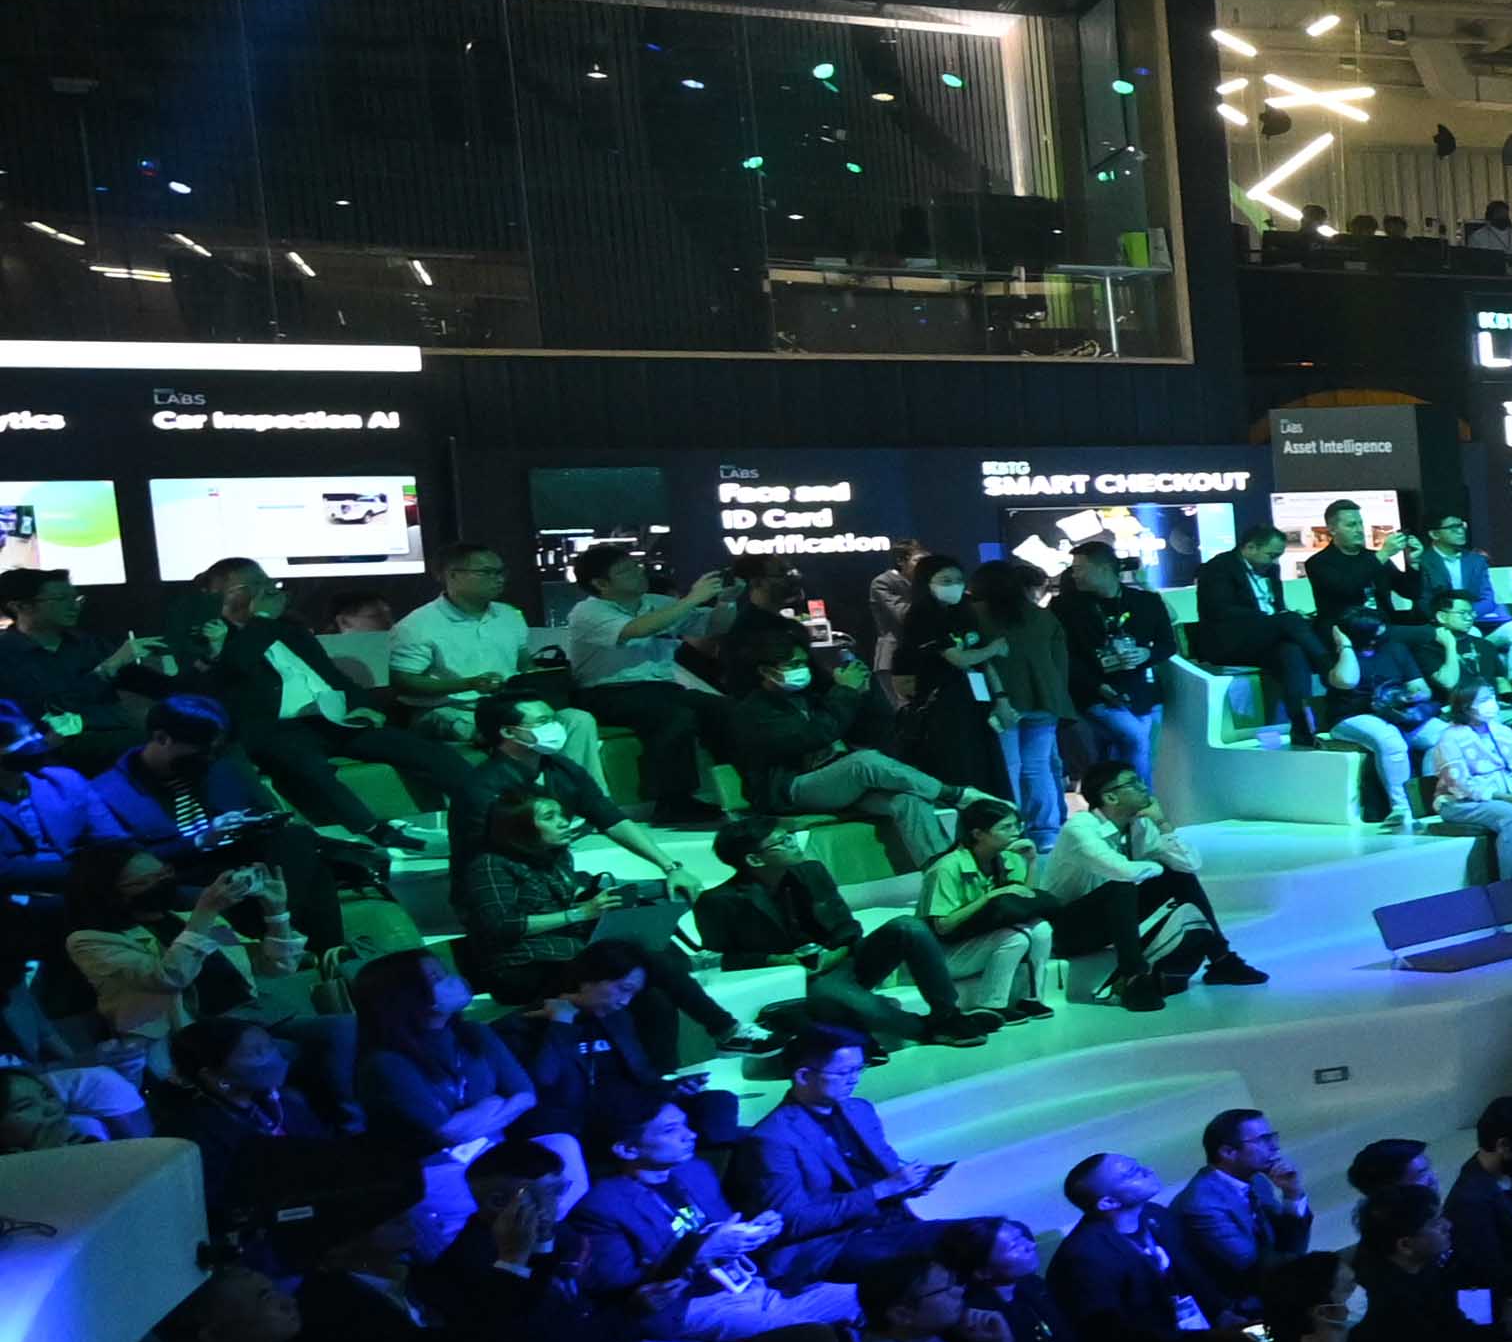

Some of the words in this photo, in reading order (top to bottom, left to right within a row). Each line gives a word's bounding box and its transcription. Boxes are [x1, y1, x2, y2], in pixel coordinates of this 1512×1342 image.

[154, 393, 207, 405] LABS
[152, 410, 208, 430] Car
[212, 410, 363, 432] Inspection
[1283, 440, 1317, 454] Asset
[1320, 439, 1393, 456] Intelligence
[719, 482, 791, 504] Face
[794, 481, 851, 503] and
[983, 474, 1090, 496] SMART
[1095, 472, 1251, 494] CHECKOUT
[721, 509, 757, 529] ID
[762, 507, 833, 529] Card
[724, 532, 891, 555] Verification
